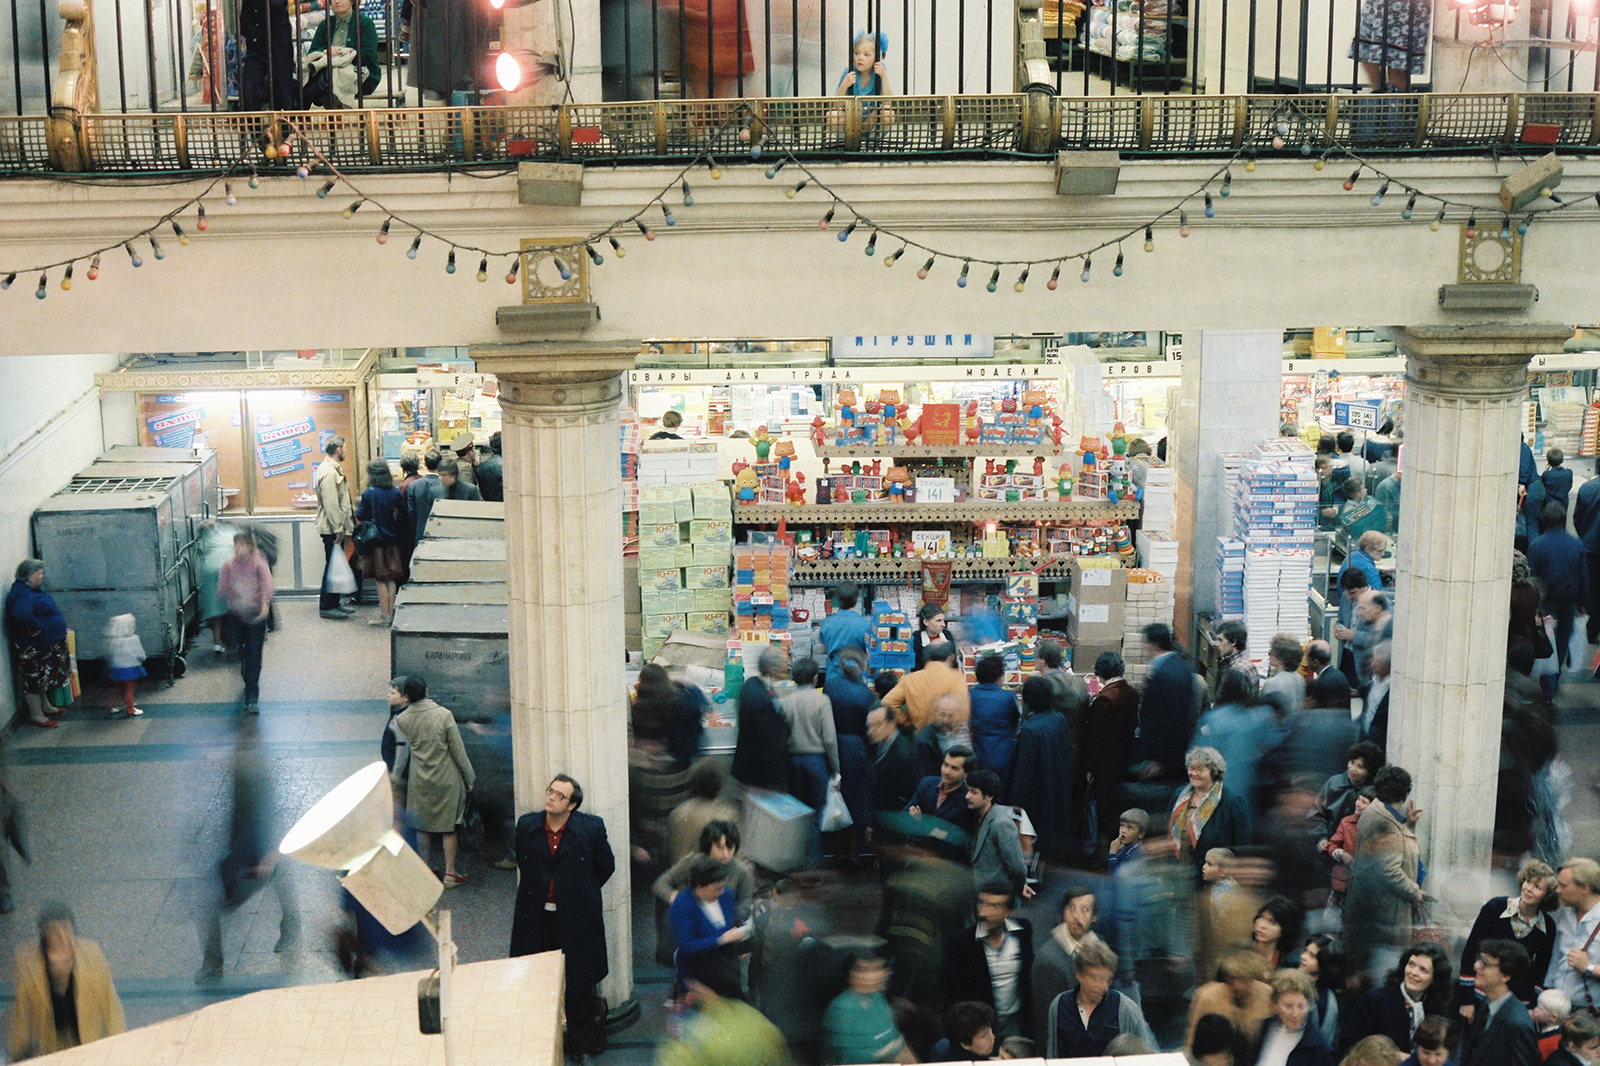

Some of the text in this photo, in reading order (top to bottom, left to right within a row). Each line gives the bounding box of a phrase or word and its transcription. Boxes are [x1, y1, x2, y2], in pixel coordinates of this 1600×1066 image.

[1171, 351, 1182, 361] 15
[1538, 358, 1546, 366] Ы
[631, 370, 851, 382] ОВАРЫ ДЛЯ ТРУДА
[966, 365, 1152, 377] МОДЕЛИ ЕРОВ
[927, 488, 942, 500] 141
[916, 533, 946, 541] СЕКЦИЯ
[923, 541, 938, 552] 141
